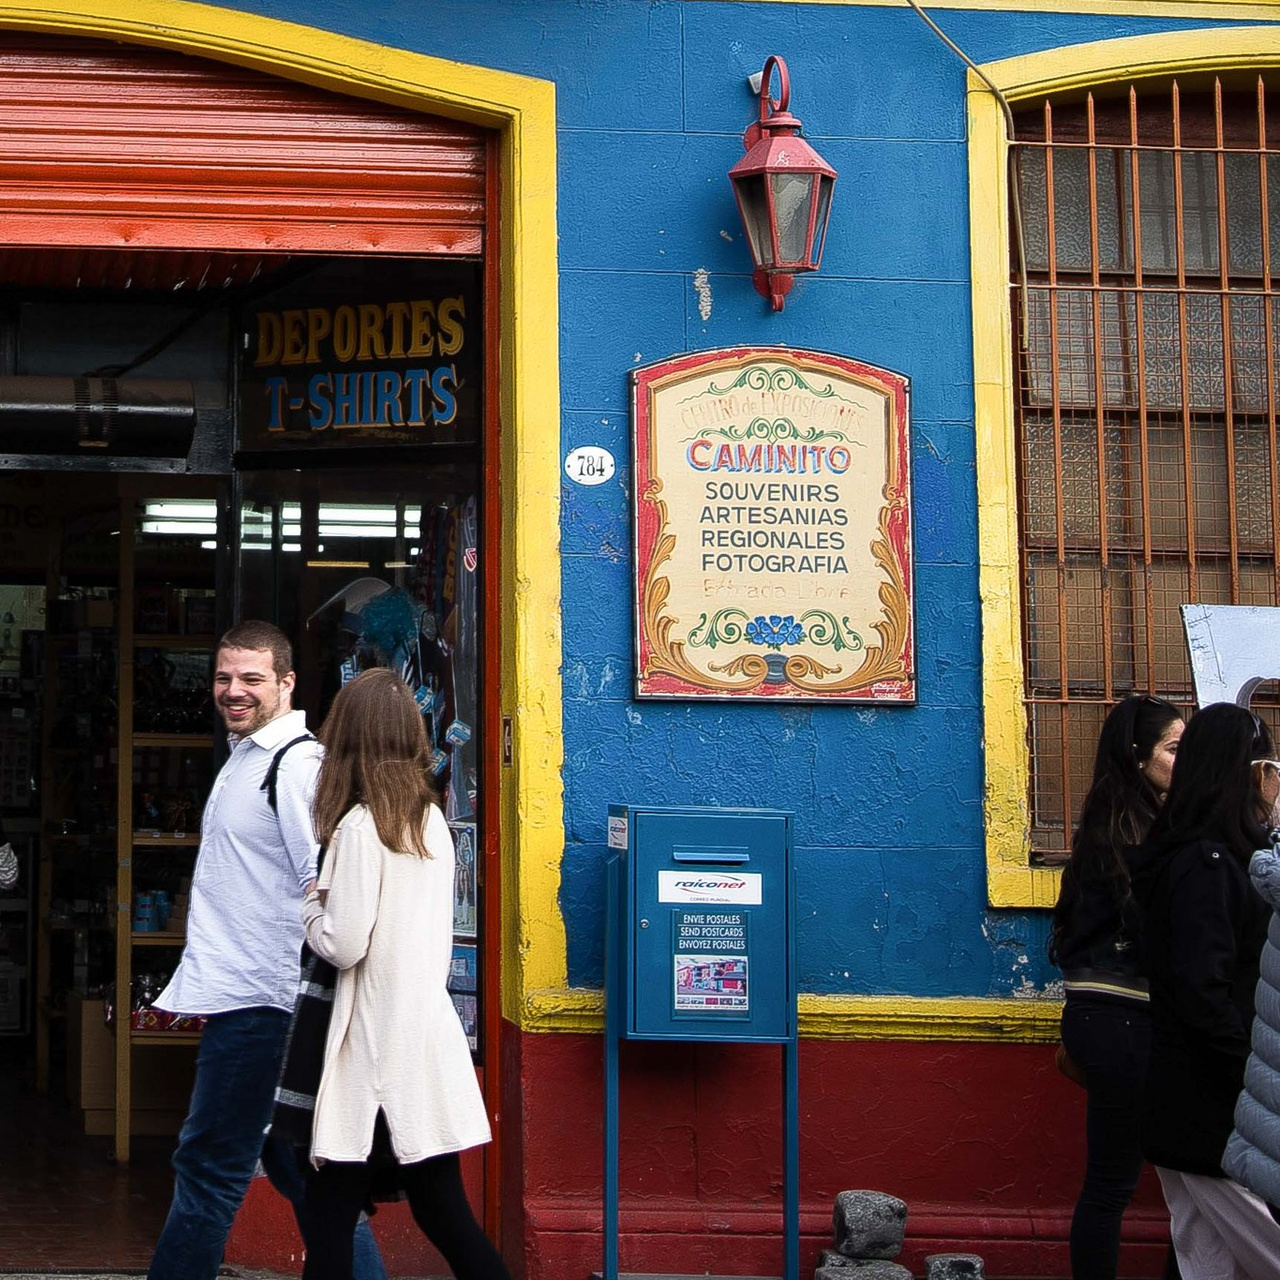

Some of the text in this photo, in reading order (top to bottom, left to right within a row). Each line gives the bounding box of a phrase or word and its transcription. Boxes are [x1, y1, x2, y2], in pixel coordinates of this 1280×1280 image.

[254, 295, 466, 367] DEPORTES
[265, 363, 459, 432] T-SHIRTS
[577, 455, 605, 476] 784
[686, 439, 851, 474] CAMINITO
[706, 482, 839, 502] SOUVENIRS
[700, 506, 848, 526] ARTESANIAS
[701, 530, 845, 550] REGIONALES
[702, 554, 849, 574] FOTOGRAFIA
[674, 879, 747, 889] raiconet
[683, 914, 741, 924] ENVIE POSTALES
[681, 927, 743, 937] SEND POSTCARDS
[679, 940, 745, 950] ENVOYEZ POSTALES
